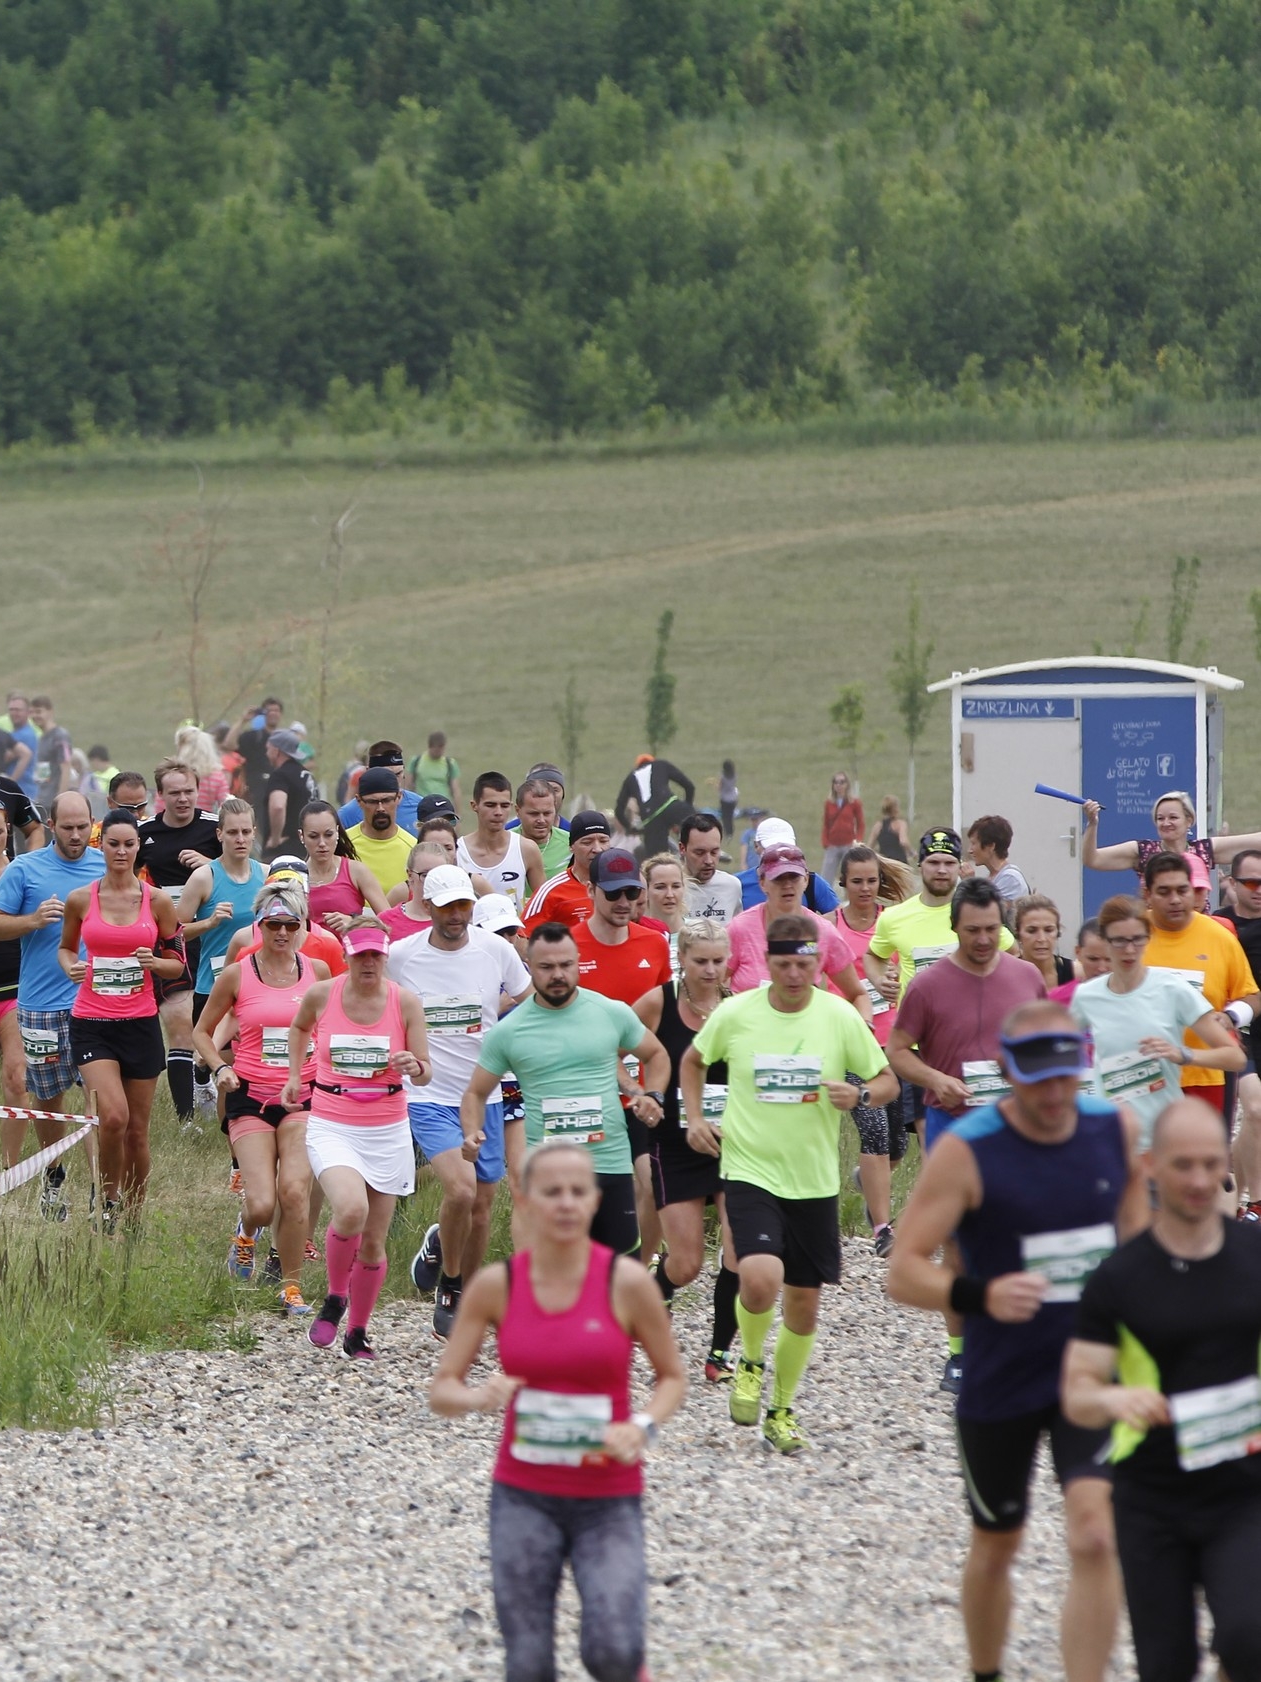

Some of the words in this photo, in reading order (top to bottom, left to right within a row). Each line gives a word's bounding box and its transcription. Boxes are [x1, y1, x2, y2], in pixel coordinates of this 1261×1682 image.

[966, 701, 1039, 715] ZMRZLINA
[1115, 758, 1150, 768] GELATO
[103, 972, 133, 983] 345
[436, 1011, 470, 1022] 282
[341, 1053, 377, 1064] 398
[768, 1075, 807, 1086] 412
[554, 1116, 589, 1128] 442
